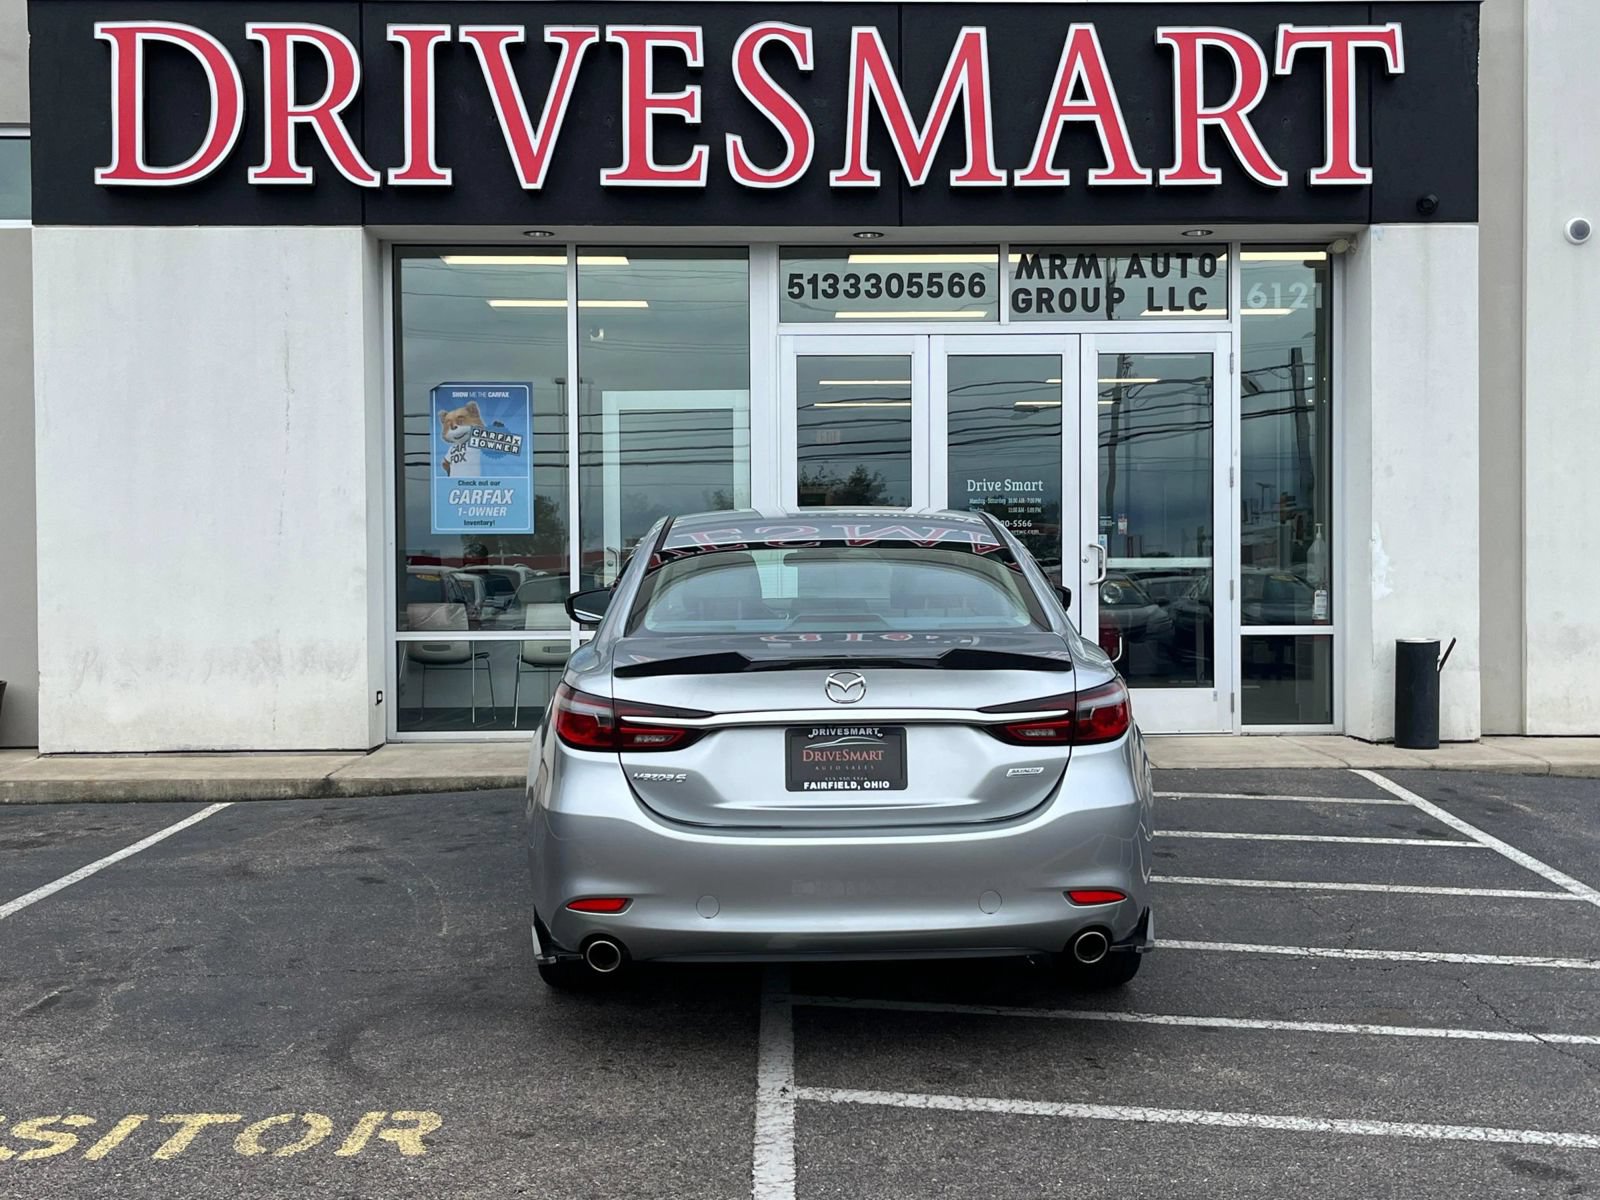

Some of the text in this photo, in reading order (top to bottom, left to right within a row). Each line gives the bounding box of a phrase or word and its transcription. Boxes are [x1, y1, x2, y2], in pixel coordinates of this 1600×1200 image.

[94, 20, 1405, 190] DRIVESMART
[1014, 252, 1217, 280] MRM AUTO
[787, 272, 986, 300] 5133305566
[1011, 286, 1208, 314] GROUP LLC
[472, 428, 521, 446] CARFAX
[479, 440, 519, 454] OWNER
[450, 452, 467, 464] FOX
[457, 479, 477, 487] Check
[967, 478, 1044, 492] Drive Smart
[448, 489, 514, 505] CARFAX
[457, 506, 507, 517] 1-OWNER
[463, 519, 496, 527] Inventory!
[812, 727, 880, 736] DRIVESMART
[802, 749, 885, 762] DRIVESMART
[803, 780, 890, 790] FAIRFIELD, OHIO
[0, 1110, 442, 1161] SITOR
